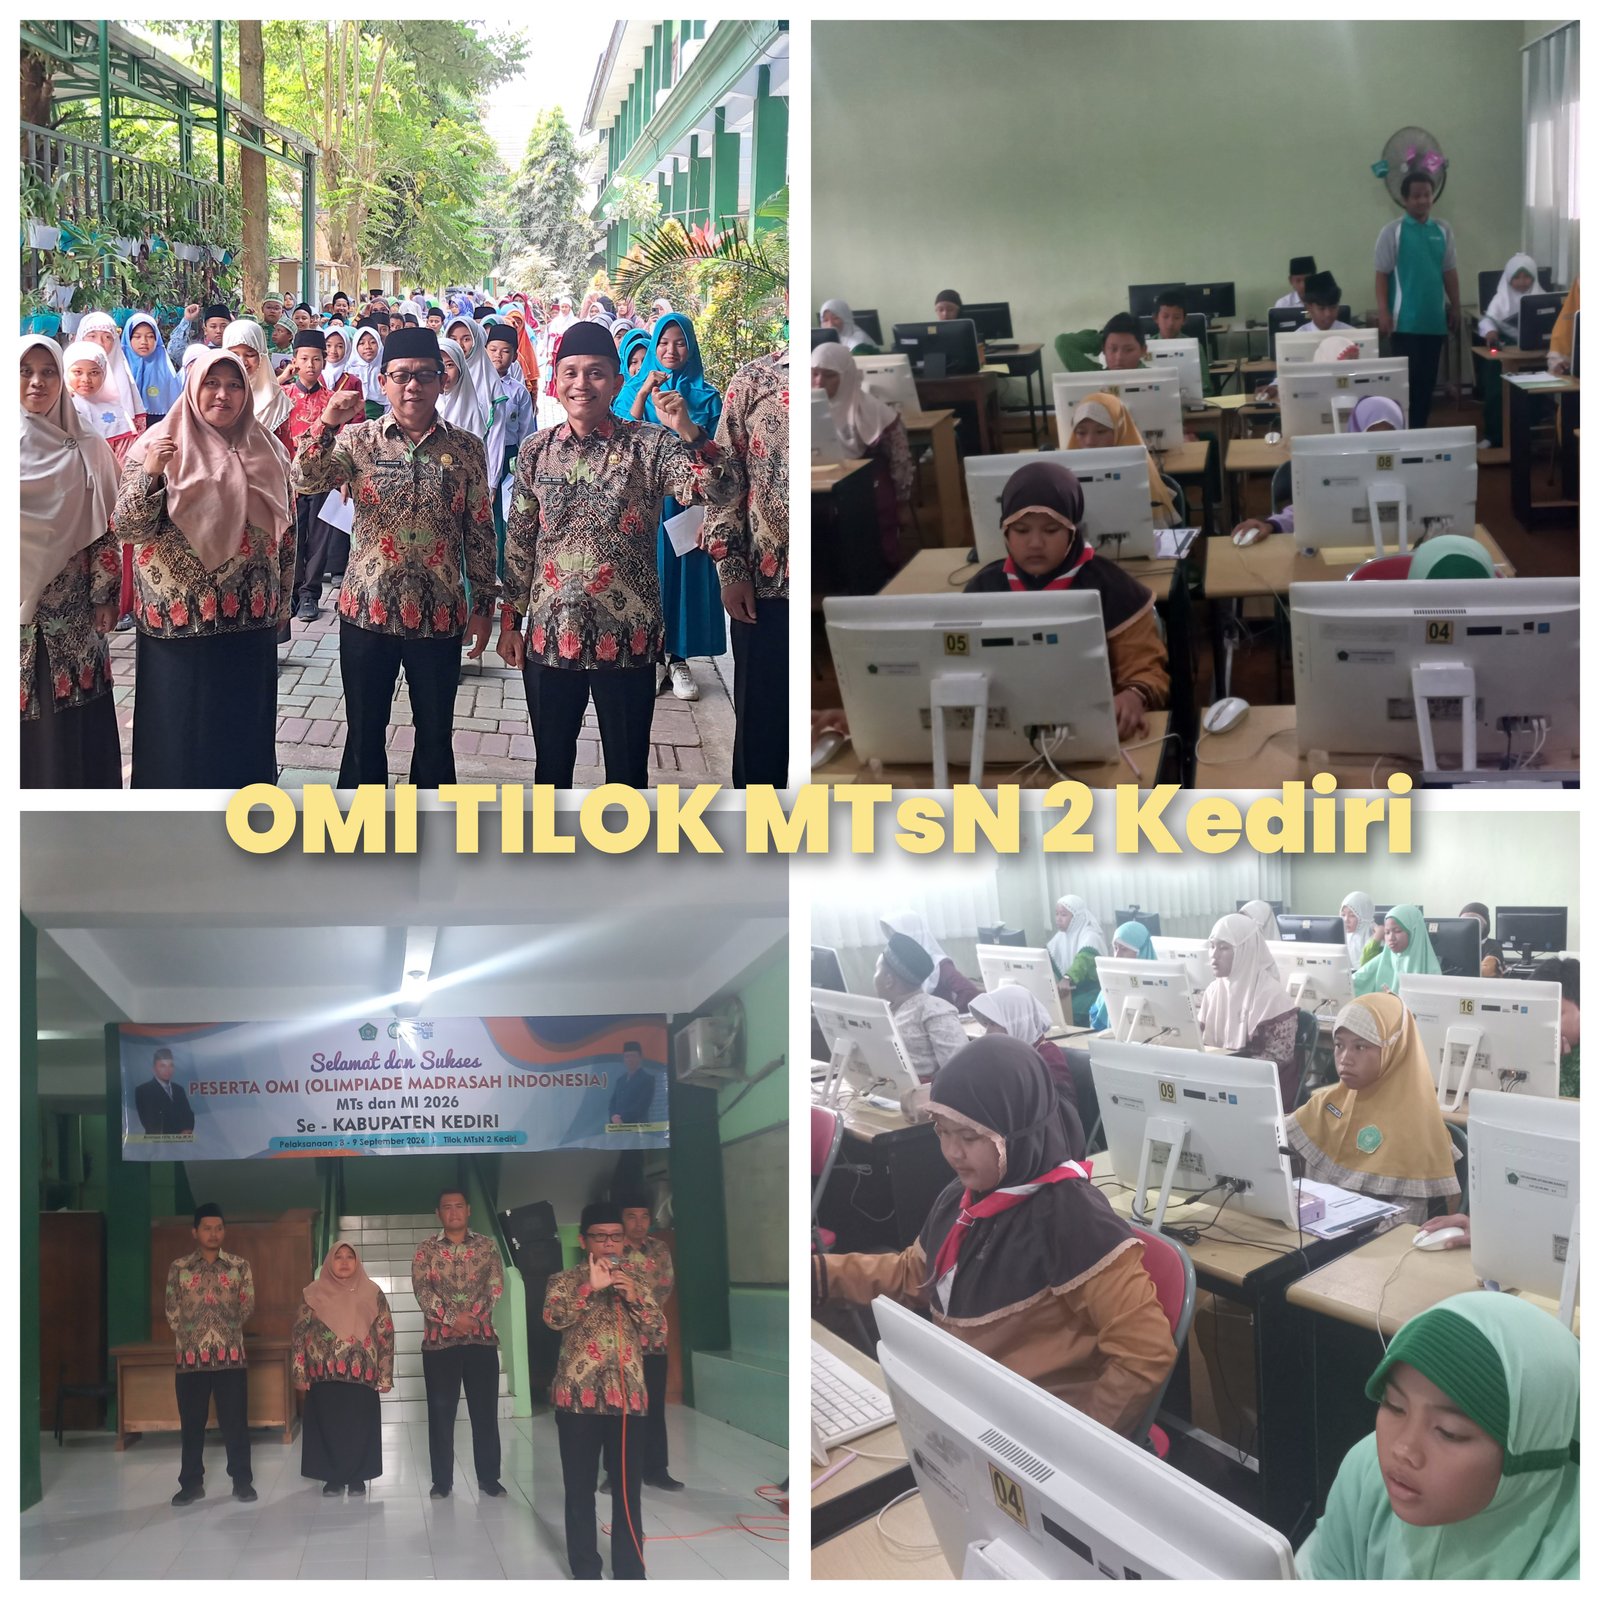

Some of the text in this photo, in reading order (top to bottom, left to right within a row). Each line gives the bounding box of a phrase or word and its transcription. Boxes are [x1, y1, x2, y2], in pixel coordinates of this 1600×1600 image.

[1378, 456, 1392, 467] 08
[1428, 622, 1450, 640] 04
[946, 634, 966, 652] 05
[1461, 1000, 1473, 1012] 16
[310, 1049, 482, 1072] Selamat dan Sukses
[189, 1072, 608, 1096] PESERTA OMI (OLIMPIADE MADRASAH INDONESIA)
[1160, 1082, 1174, 1099] 09
[336, 1096, 459, 1111] MTs dan MI 2026
[296, 1118, 316, 1133] Se
[333, 1115, 435, 1132] KABUPATEN
[441, 1114, 499, 1129] KEDIRI
[280, 1140, 332, 1148] Pelaksanaan
[360, 1138, 404, 1146] September
[993, 1470, 1022, 1517] 04
